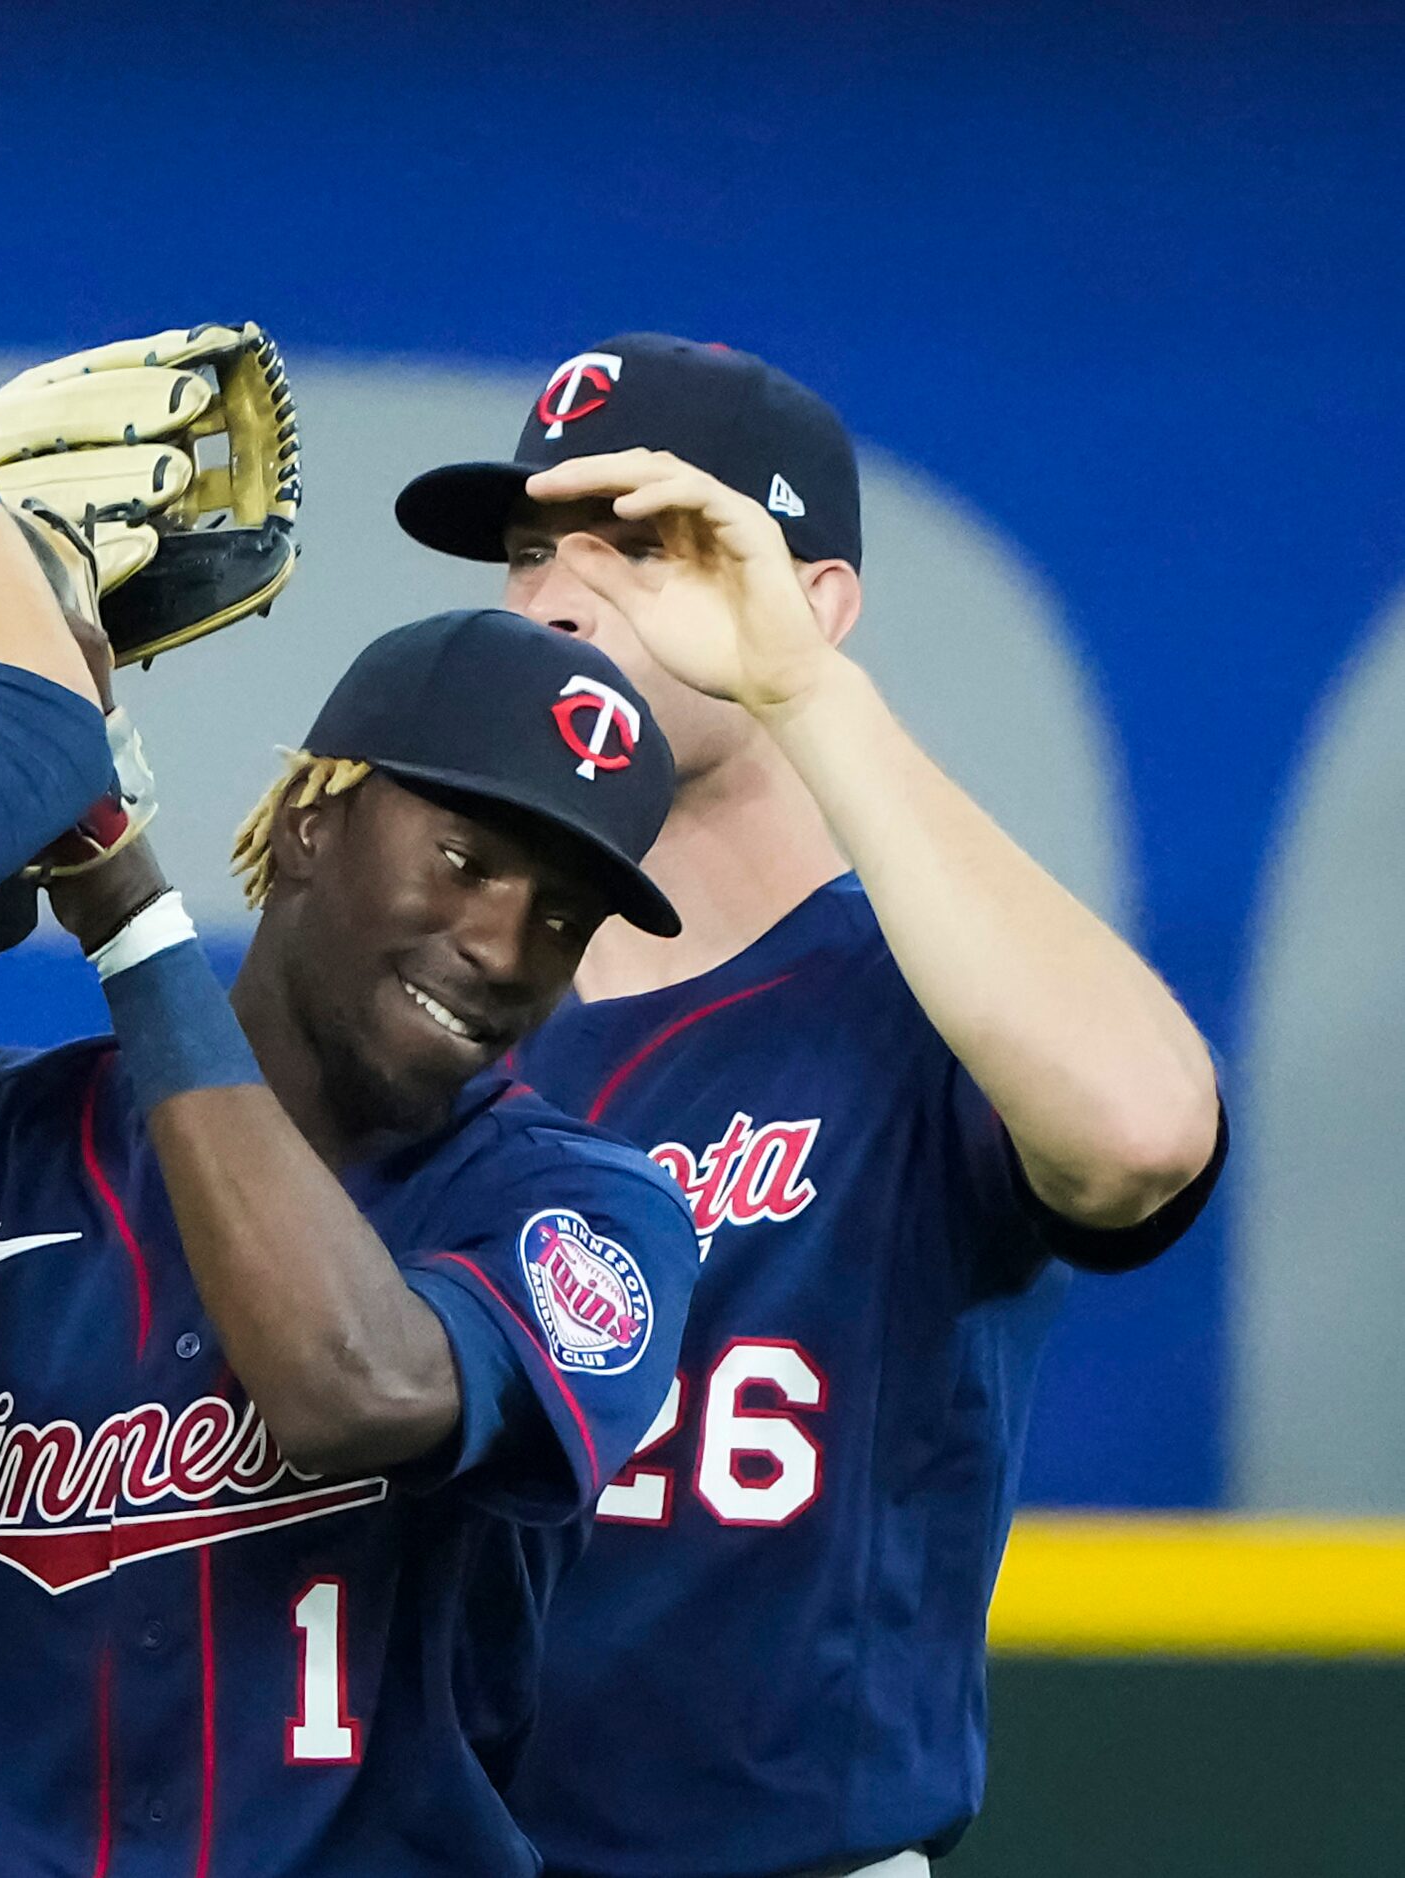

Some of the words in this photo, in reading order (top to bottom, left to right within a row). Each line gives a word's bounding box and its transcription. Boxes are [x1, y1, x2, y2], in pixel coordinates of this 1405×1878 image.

[537, 1226, 640, 1346] Twins
[556, 1217, 646, 1320] MINNESOTA
[562, 1351, 606, 1367] CLUB
[284, 1575, 363, 1765] 1
